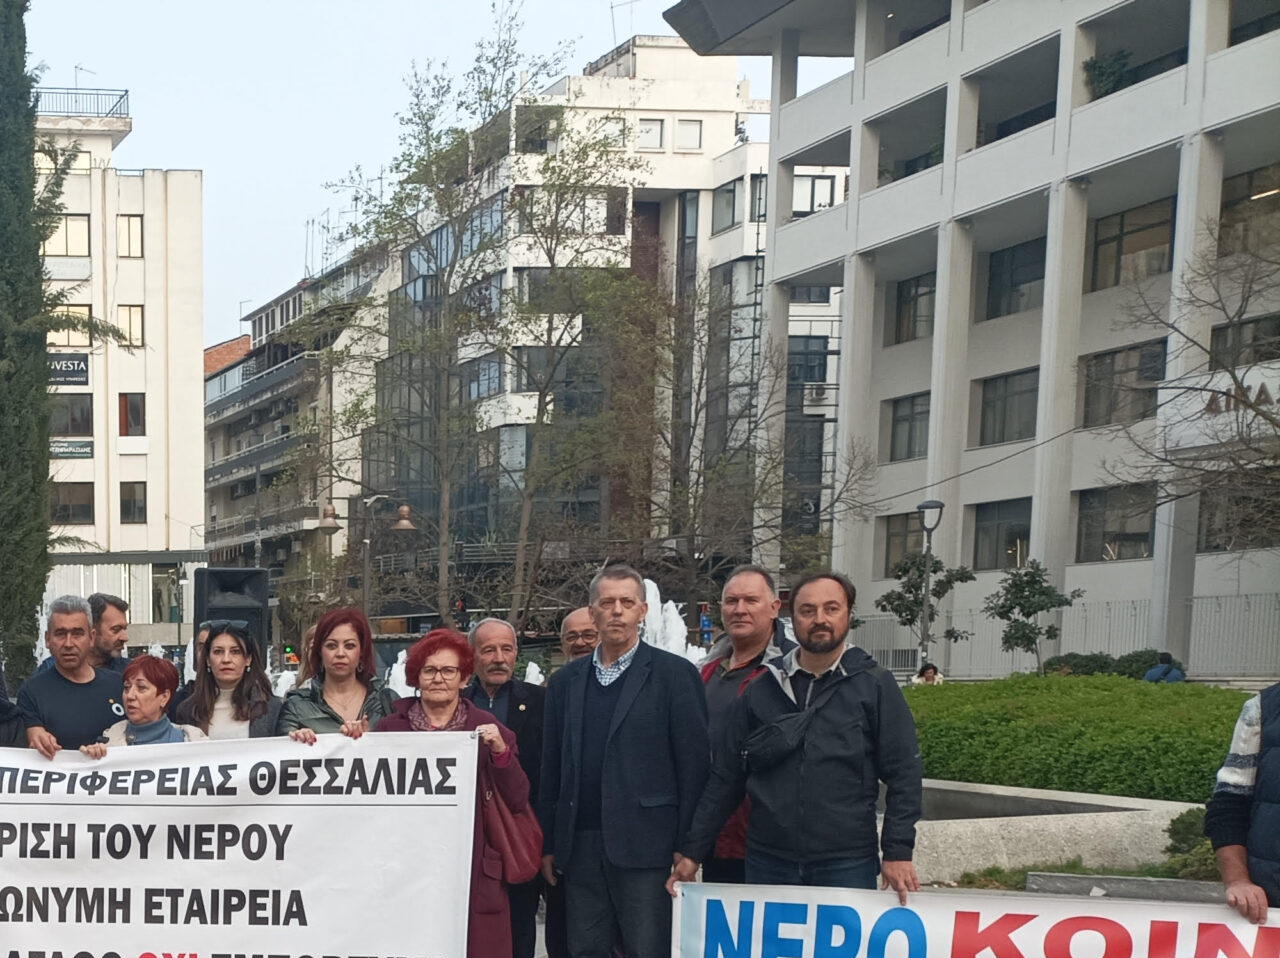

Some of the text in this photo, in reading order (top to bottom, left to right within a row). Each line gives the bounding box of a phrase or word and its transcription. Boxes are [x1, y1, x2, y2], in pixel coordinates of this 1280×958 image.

[249, 757, 457, 796] ΘΕΣΣΑΛΙΑΣ
[87, 823, 157, 860] ΤΟΥ
[167, 823, 293, 861] ΝΕΡΟΥ
[144, 888, 308, 926] ΕΤΑΙΡΕΙΑ
